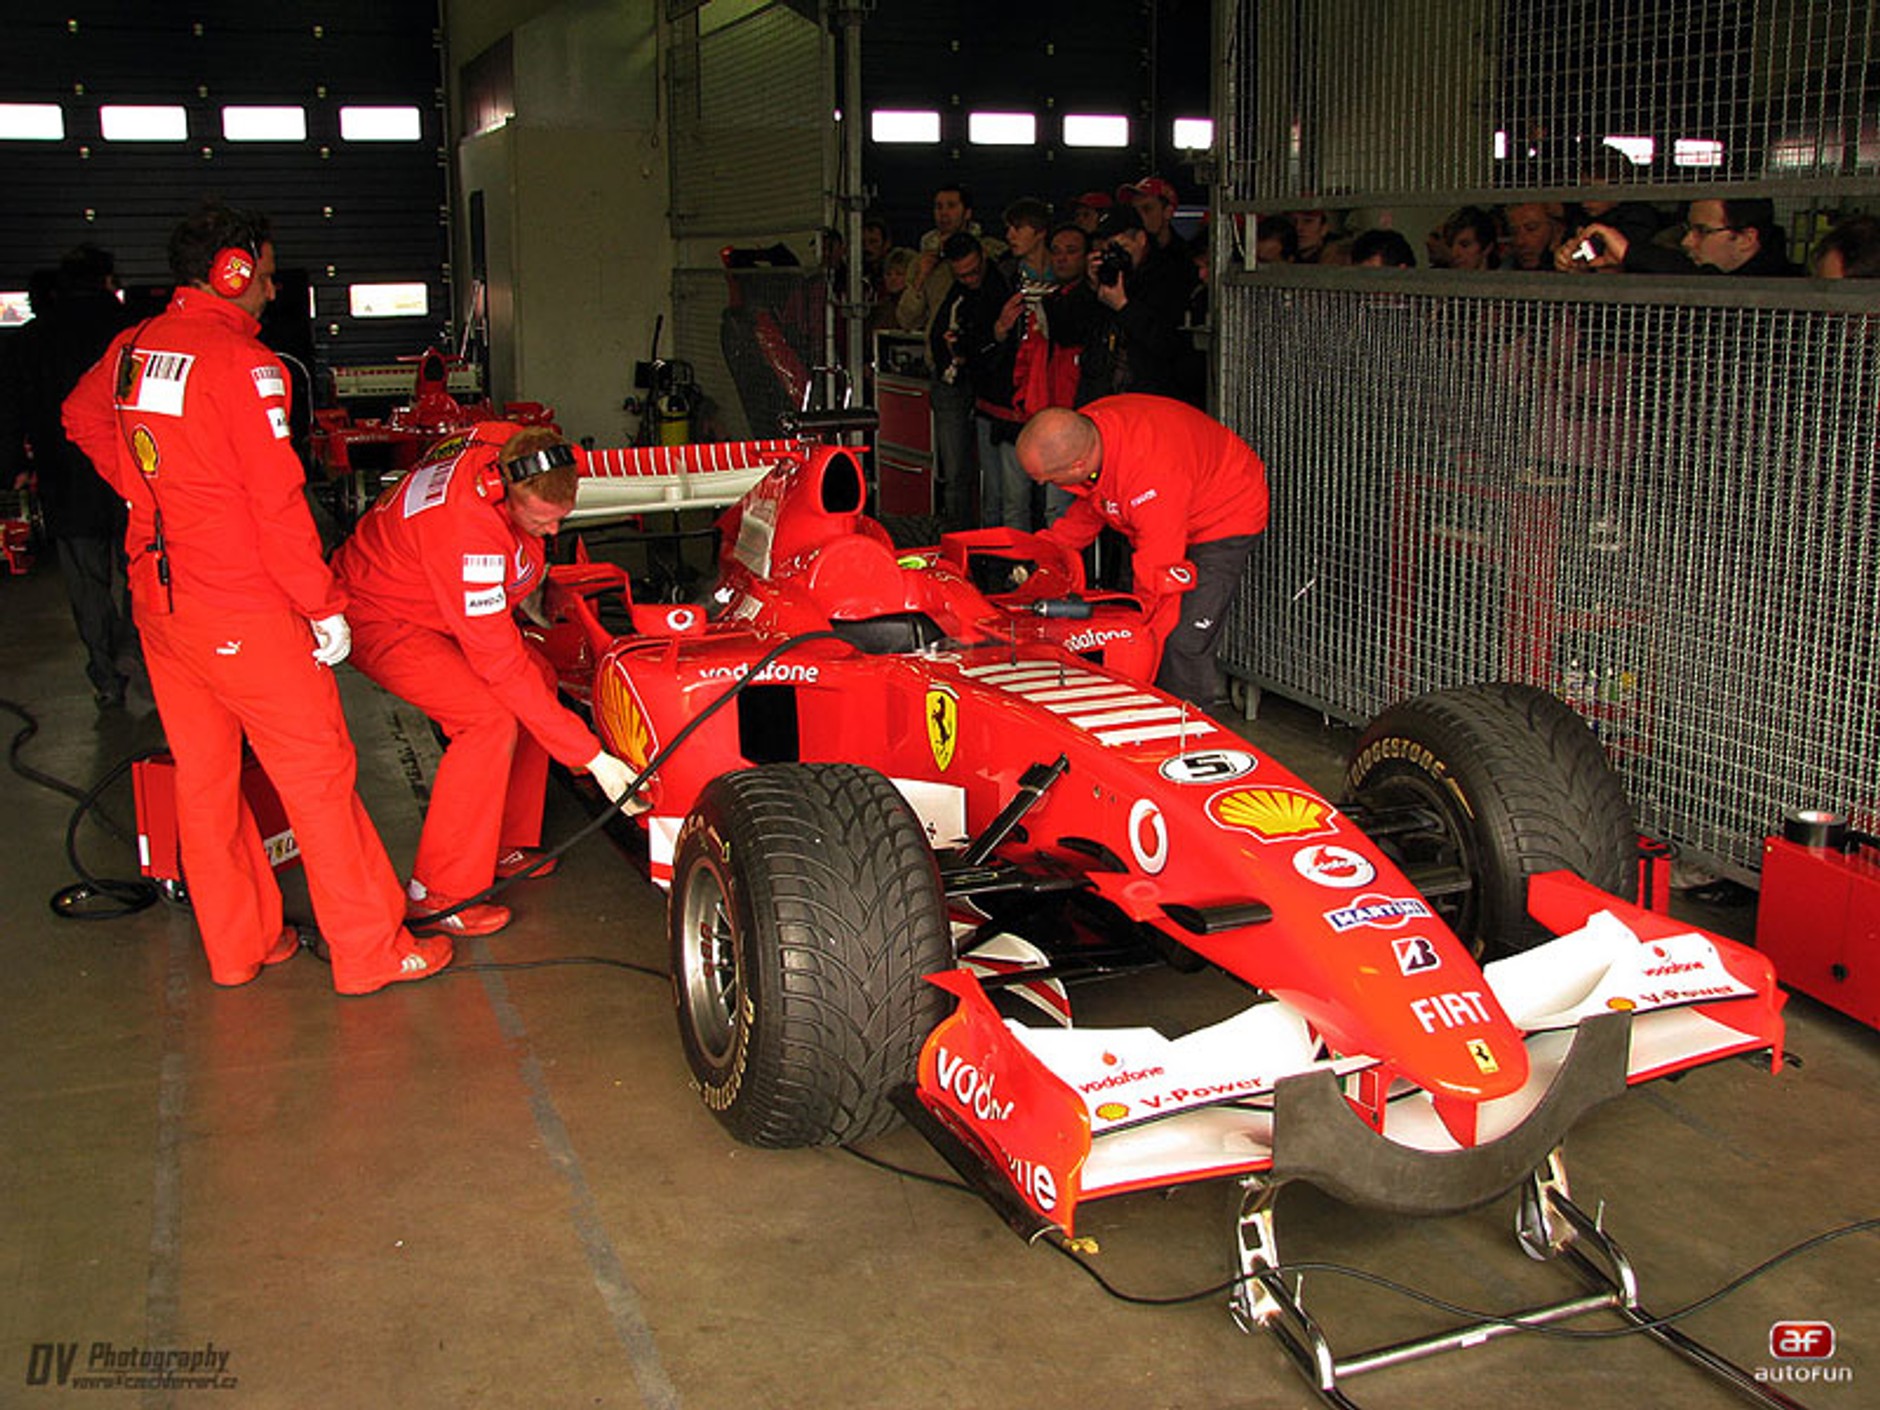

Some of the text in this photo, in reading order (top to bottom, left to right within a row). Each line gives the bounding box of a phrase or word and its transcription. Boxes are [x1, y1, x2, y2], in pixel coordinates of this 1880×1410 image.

[1329, 900, 1428, 928] MARTINI
[1410, 991, 1491, 1033] FIAT
[1078, 1066, 1165, 1094] vodafone
[1139, 1076, 1262, 1109] V-Power
